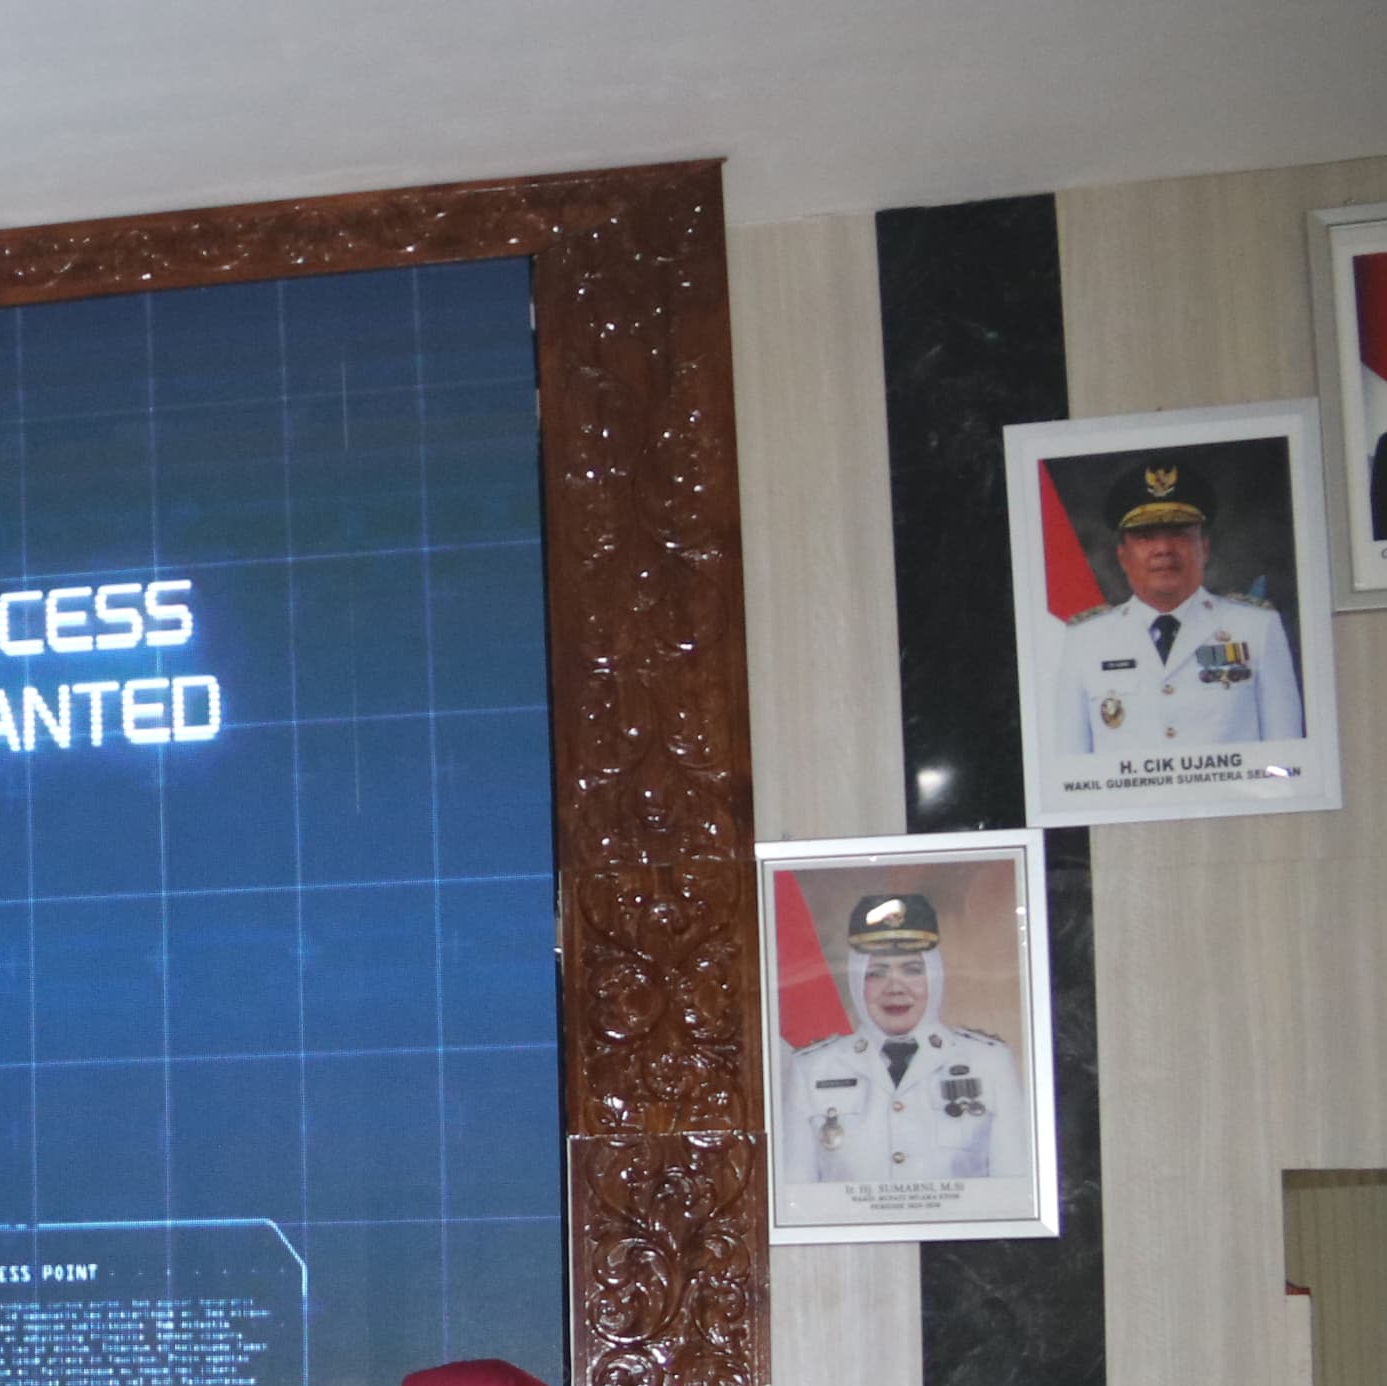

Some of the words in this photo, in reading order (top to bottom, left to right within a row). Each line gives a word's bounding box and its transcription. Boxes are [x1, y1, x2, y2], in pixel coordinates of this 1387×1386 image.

[1120, 760, 1137, 775] H.
[1143, 758, 1174, 772] CIK
[1180, 753, 1242, 770] UJANG
[1063, 779, 1102, 792] WAKIL
[1106, 775, 1173, 789] GUBERNUR
[1177, 770, 1243, 784] SUMATERA
[42, 1263, 98, 1282] POINT
